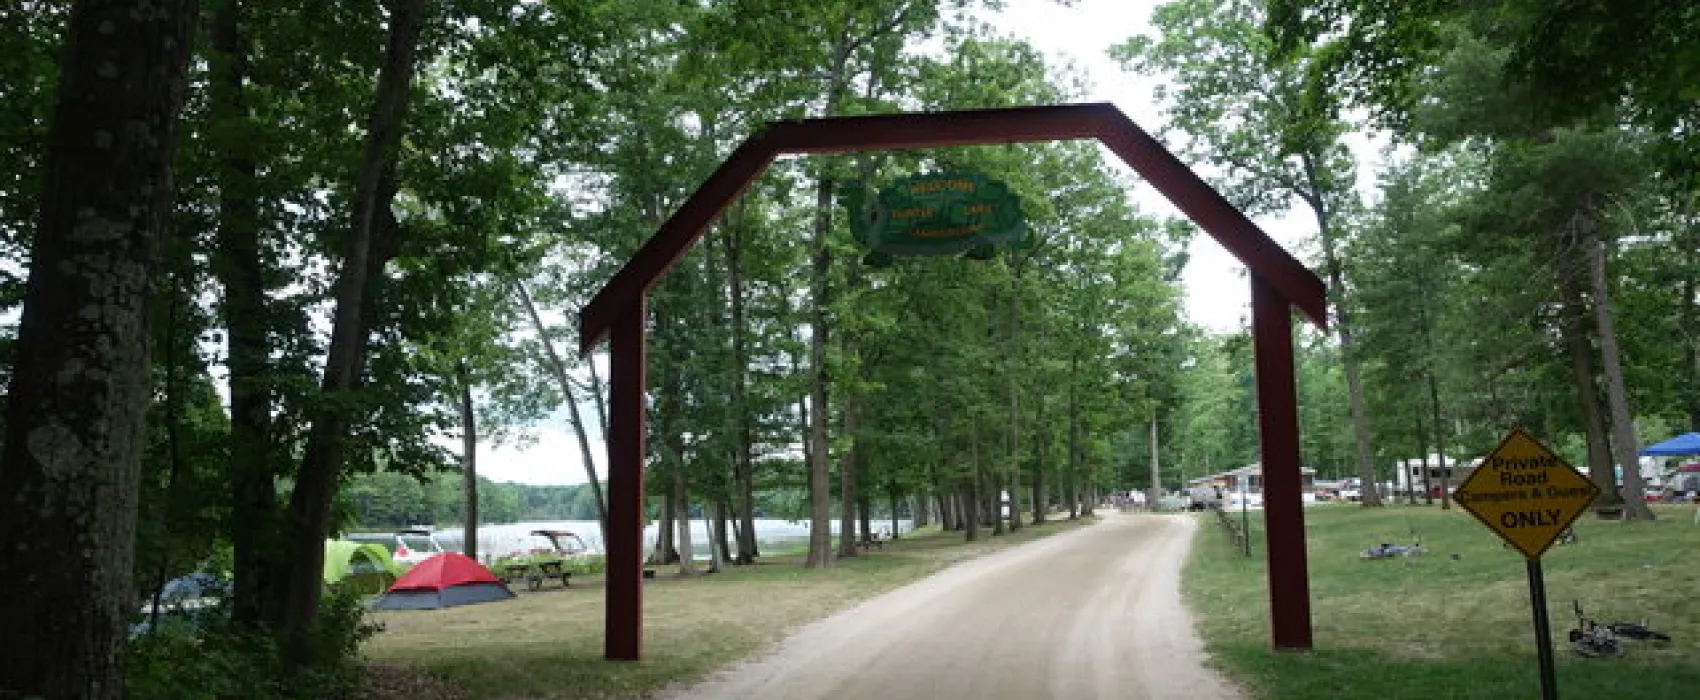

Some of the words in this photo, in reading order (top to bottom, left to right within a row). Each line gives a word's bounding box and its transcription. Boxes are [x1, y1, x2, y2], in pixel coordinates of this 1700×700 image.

[1492, 455, 1559, 471] Private
[1500, 471, 1548, 485] Road
[1532, 487, 1542, 498] &
[1500, 509, 1561, 528] ONLY
